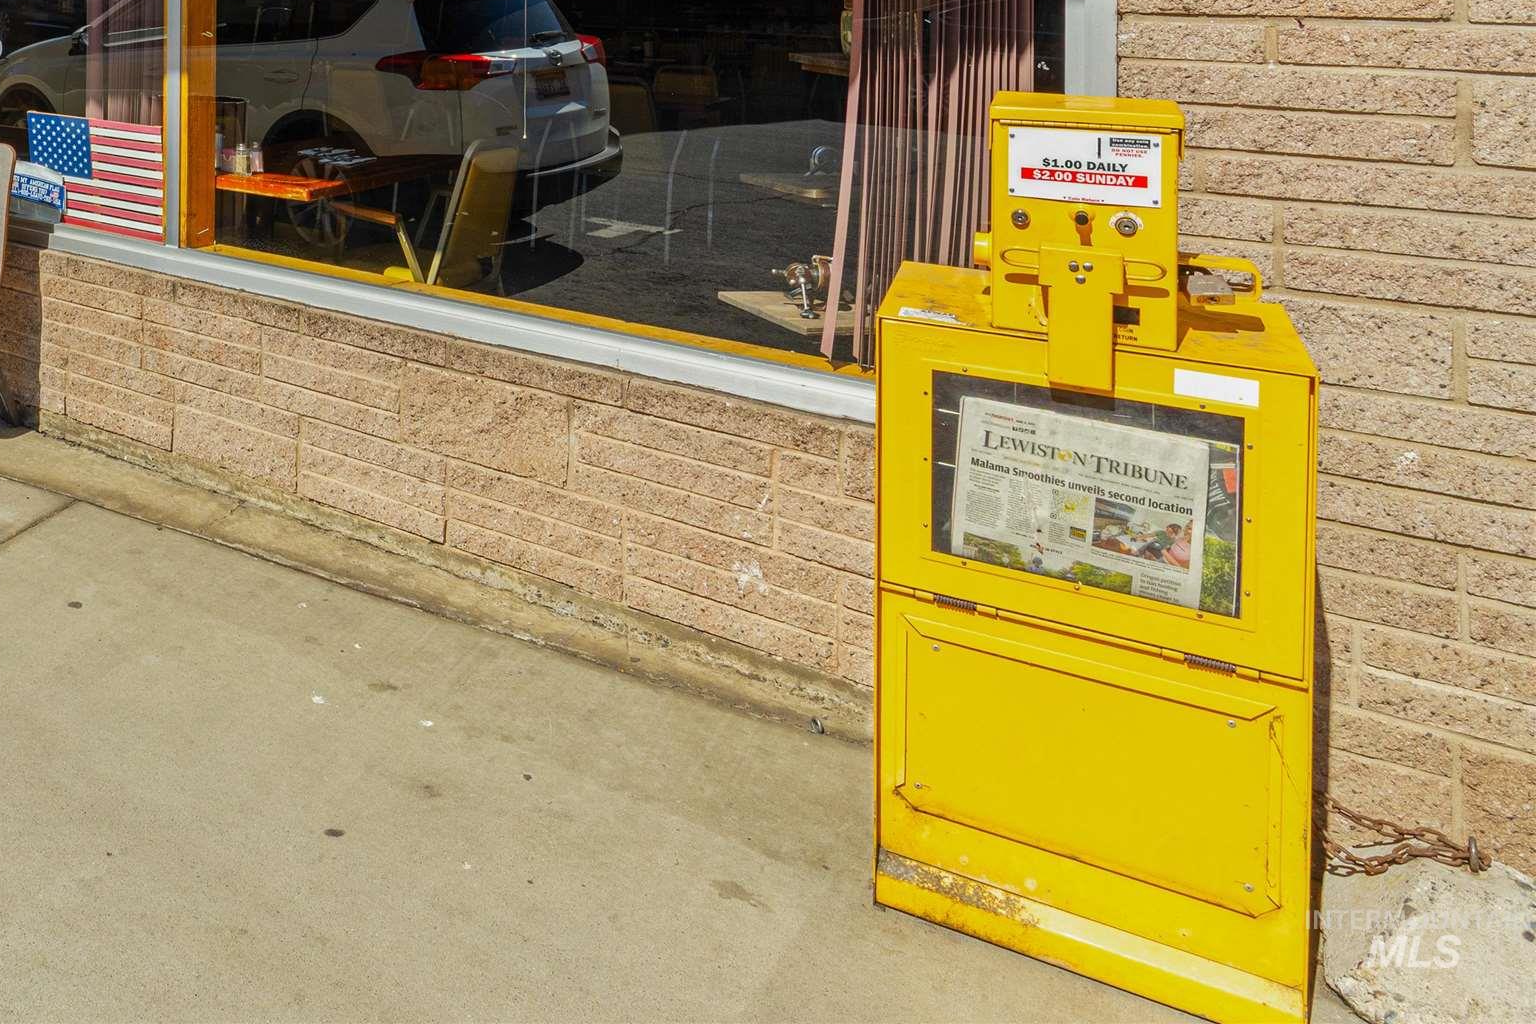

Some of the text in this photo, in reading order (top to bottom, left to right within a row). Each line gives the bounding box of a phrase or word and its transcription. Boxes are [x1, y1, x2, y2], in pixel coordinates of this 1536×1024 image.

[1032, 168, 1136, 186] $2.00 SUNDAY
[1042, 157, 1129, 173] $1.00 DAILY
[1090, 454, 1189, 490] TRIBUNE
[970, 457, 1010, 475] Malama
[1012, 467, 1066, 488] Smoothies
[1068, 481, 1106, 497] unveils
[1108, 489, 1146, 507] second
[1148, 497, 1194, 516] location
